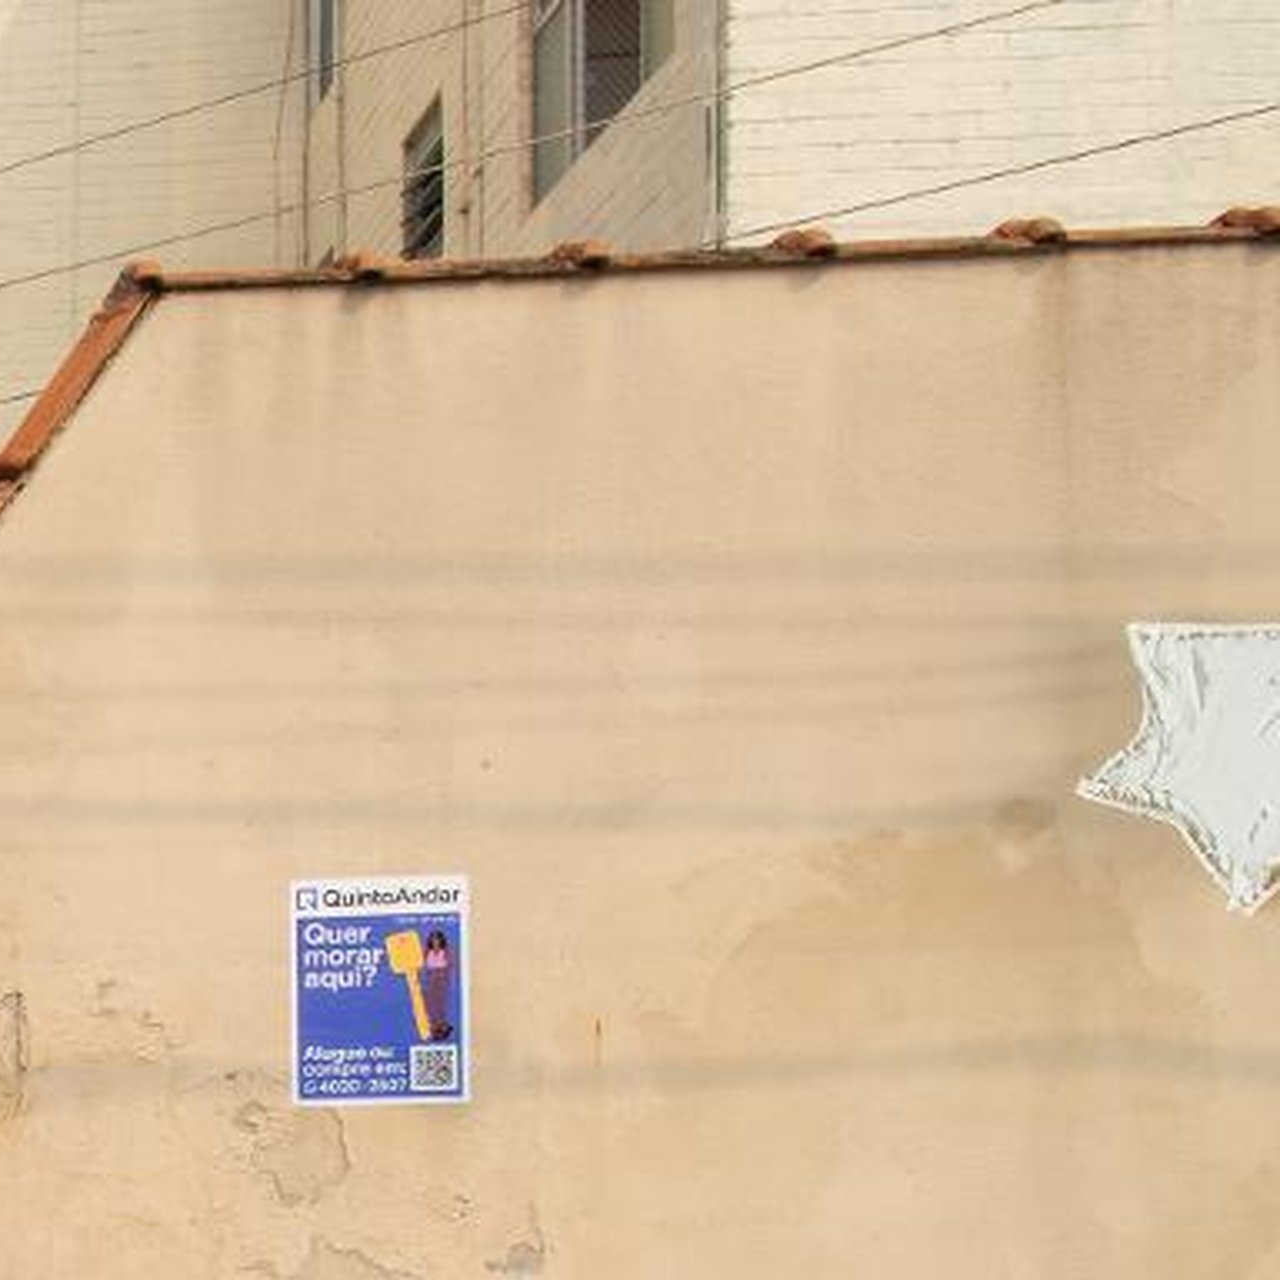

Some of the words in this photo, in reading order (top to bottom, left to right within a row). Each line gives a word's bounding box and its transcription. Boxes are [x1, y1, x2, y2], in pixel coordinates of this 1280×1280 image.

[322, 887, 460, 907] QuintoAndar
[303, 922, 372, 946] Quer
[303, 948, 384, 966] morar
[303, 966, 378, 992] aqui?
